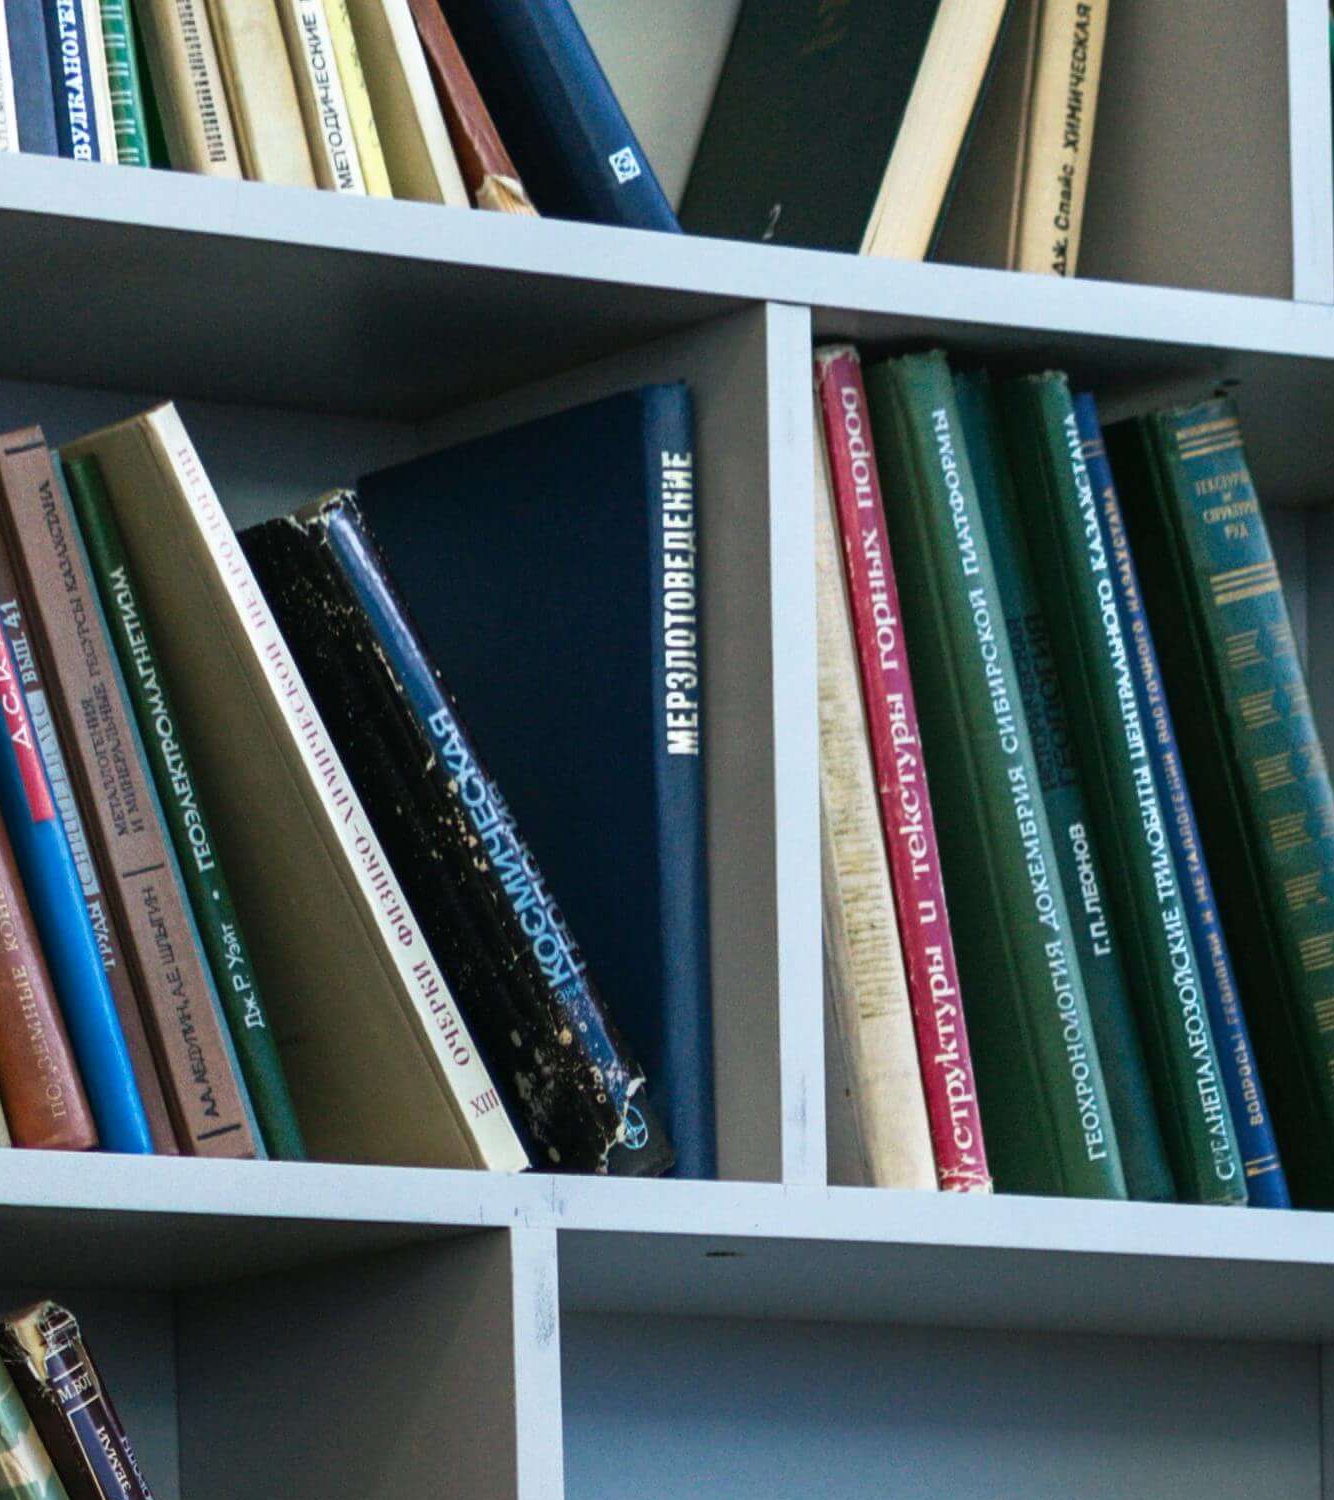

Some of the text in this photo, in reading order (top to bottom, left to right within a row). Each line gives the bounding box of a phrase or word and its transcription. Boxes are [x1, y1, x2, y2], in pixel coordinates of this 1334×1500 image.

[300, 11, 355, 190] МЕТОДИЧЕСКИЕ
[1062, 2, 1093, 153] ХИМИЧЕСКАЯ
[836, 382, 881, 511] пород
[1060, 411, 1108, 572] КАЗАХСТАНА
[0, 597, 24, 630] 41
[661, 450, 698, 755] МЕРЗЛОТОВЕДЕНИЕ
[858, 526, 900, 672] горных
[1093, 577, 1147, 759] ЦЕНТРАЛЬНОГО
[104, 564, 218, 871] ГЕОЭЛЕКТРОМАГНЕТИЗМ
[881, 690, 937, 881] текстуры
[928, 406, 1109, 1161] ГЕОХРОНОЛОГИЯ ДОКЕМБРИЯ СИБИРСКОЙ ПЛАТФОРМЫ
[257, 638, 476, 1069] ОЧЕРКИ ФИЗИКО-ХИМИЧЕСКОЙ
[418, 705, 578, 988] КОСМИЧЕСКАЯ
[913, 897, 937, 925] и
[1131, 762, 1177, 900] ТРИЛОБИТЫ
[94, 1423, 134, 1494] ЗЕМЛИ
